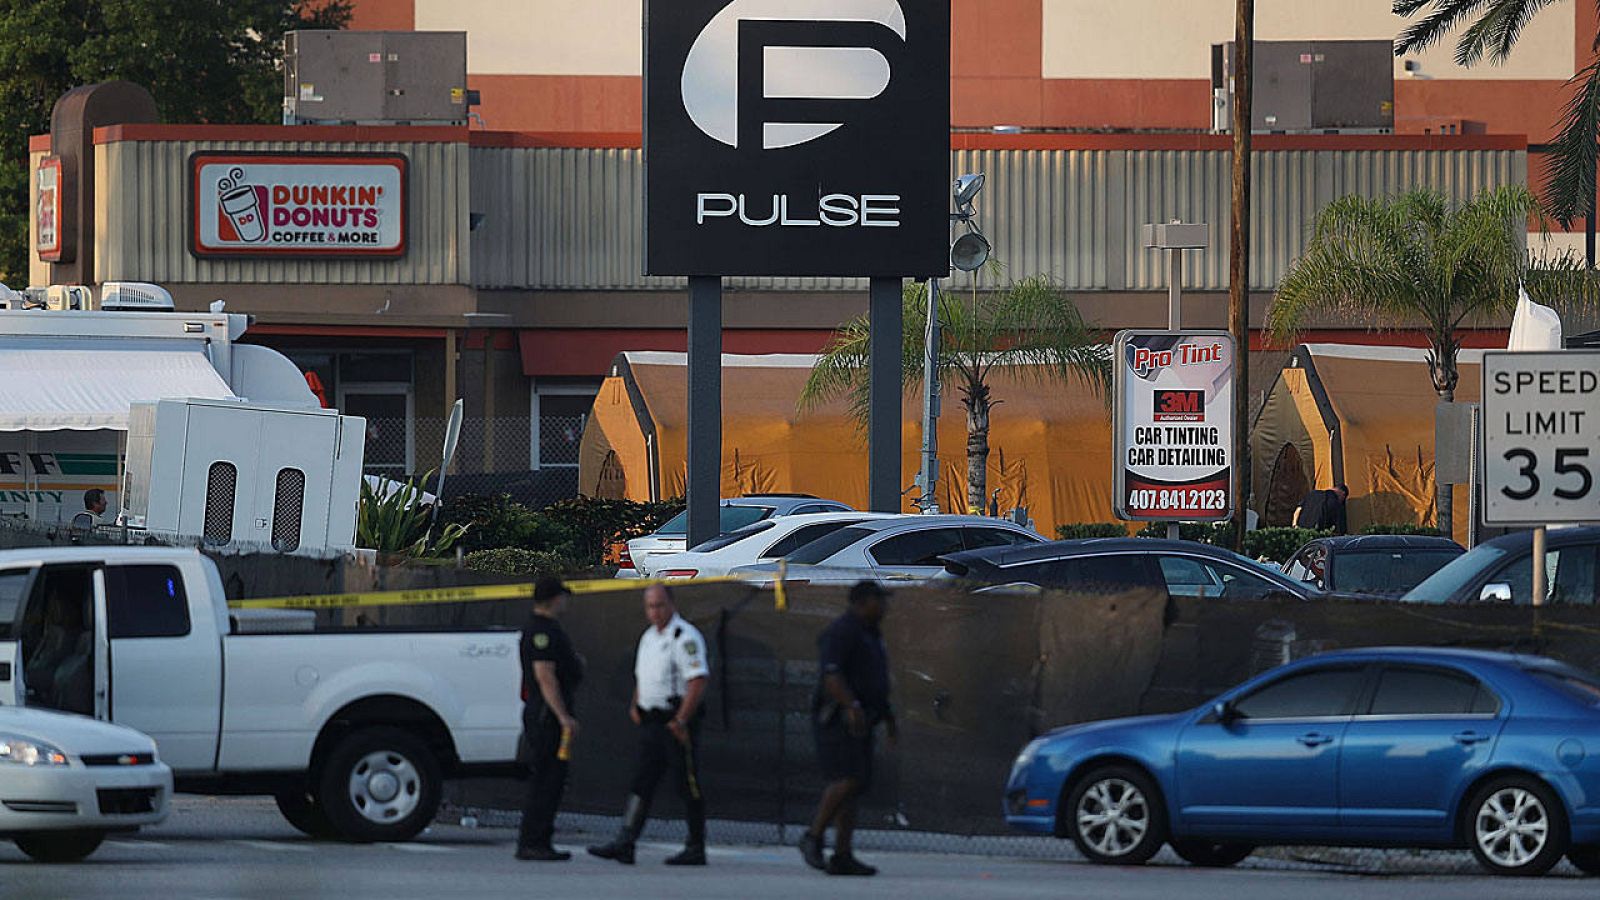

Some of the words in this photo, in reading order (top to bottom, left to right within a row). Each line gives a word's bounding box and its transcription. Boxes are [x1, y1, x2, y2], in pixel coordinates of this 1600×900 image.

[272, 185, 384, 206] DUNKIN'
[238, 213, 255, 226] DD
[272, 207, 378, 228] DONUTS
[696, 193, 901, 227] PULSE
[272, 231, 325, 243] COFFEE
[327, 231, 336, 242] &
[337, 231, 378, 243] MORE
[1134, 348, 1173, 370] Pro
[1179, 343, 1222, 365] Tint
[1494, 370, 1598, 395] SPEED
[1160, 391, 1199, 412] 3M
[1505, 410, 1586, 435] LIMIT
[1135, 427, 1162, 445] CAR
[1164, 427, 1219, 445] TINTING
[1128, 448, 1155, 466] CAR
[1157, 448, 1226, 466] DETAILING
[1500, 447, 1593, 501] 35
[1129, 489, 1226, 510] 407.841.2123
